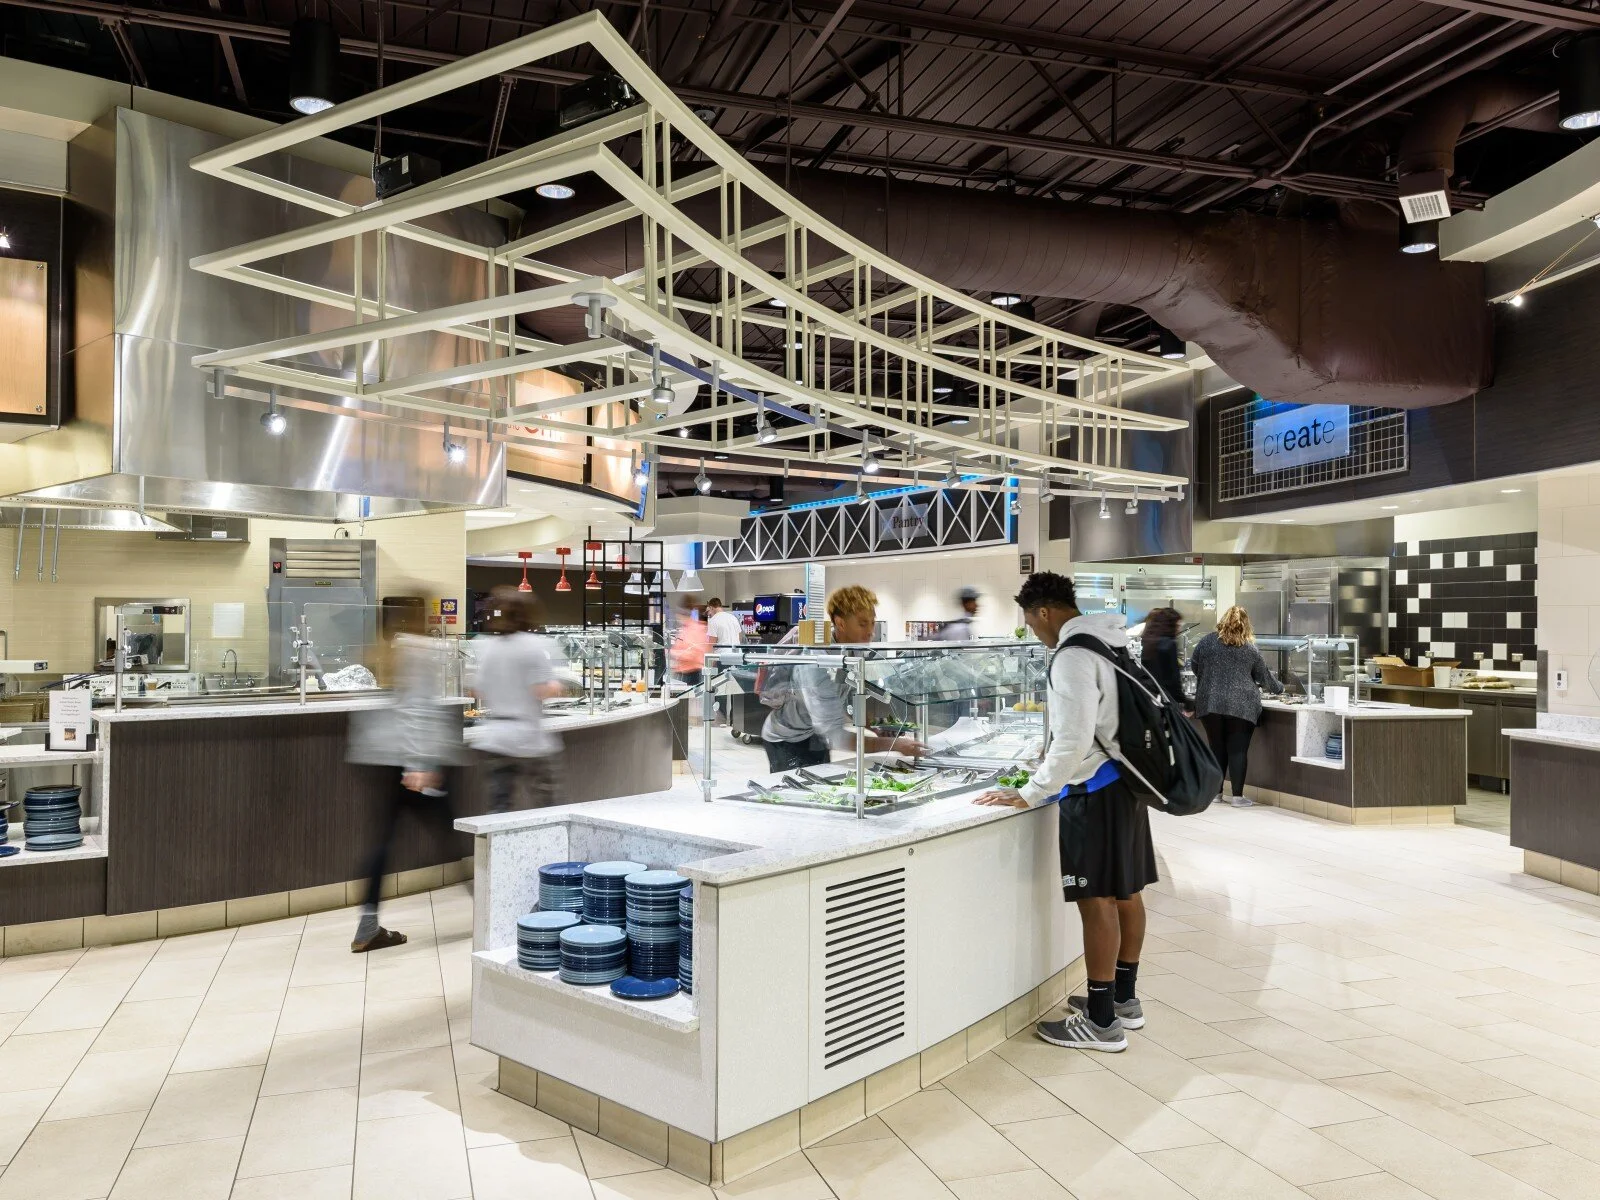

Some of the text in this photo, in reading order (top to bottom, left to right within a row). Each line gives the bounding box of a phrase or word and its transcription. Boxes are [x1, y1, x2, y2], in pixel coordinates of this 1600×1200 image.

[1263, 418, 1335, 457] create
[892, 516, 924, 529] Pantry
[762, 604, 775, 613] pepsi
